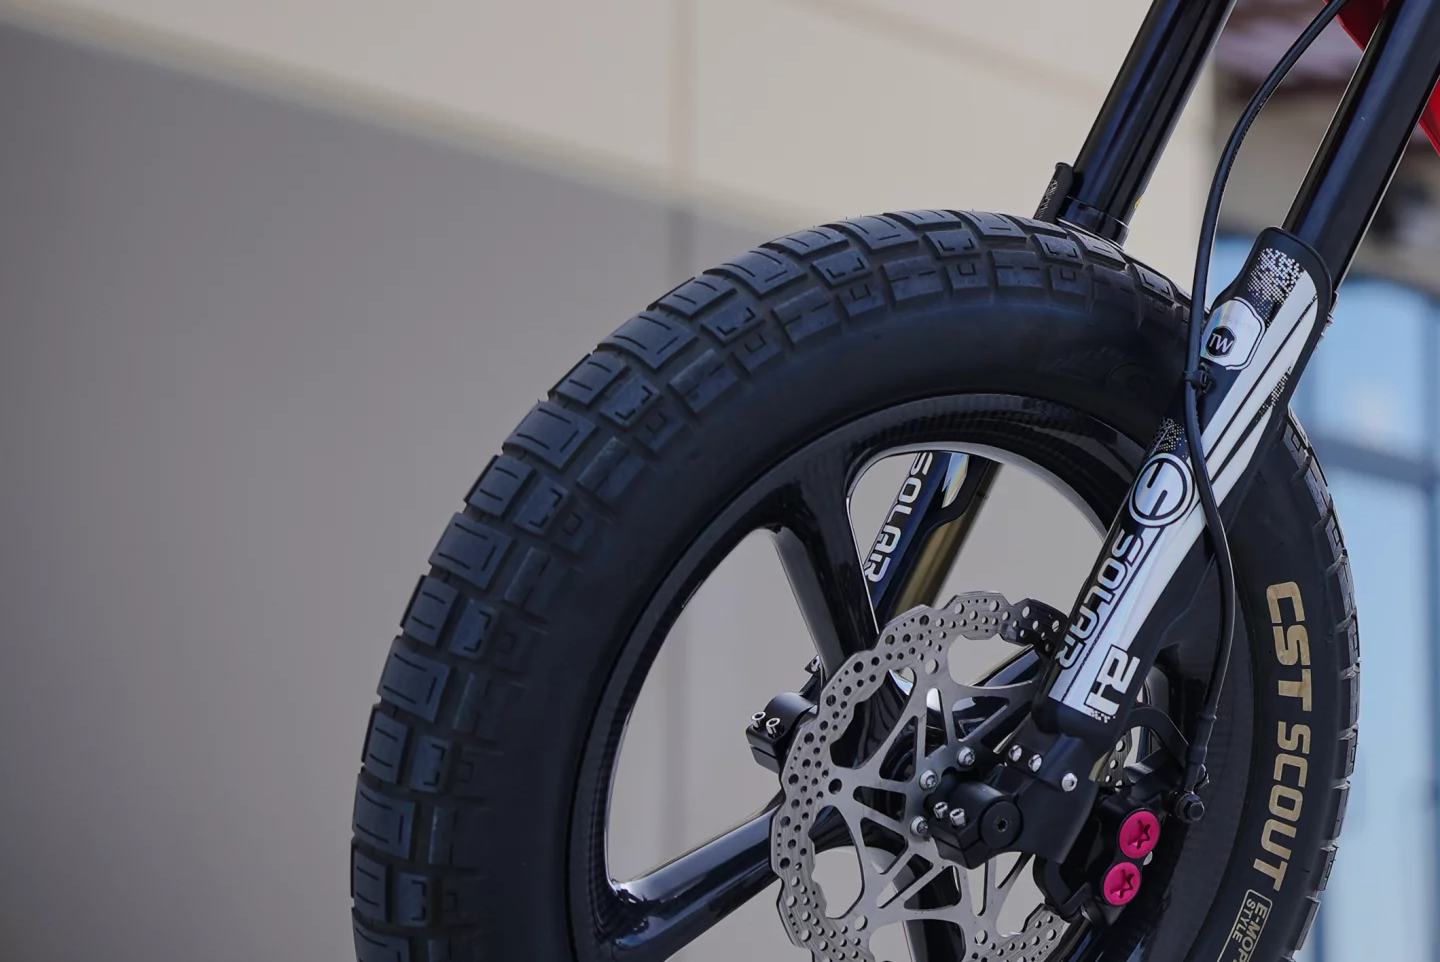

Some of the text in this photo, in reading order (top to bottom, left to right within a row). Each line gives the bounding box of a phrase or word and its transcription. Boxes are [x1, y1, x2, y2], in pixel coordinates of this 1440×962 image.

[1209, 333, 1233, 353] TW
[864, 452, 933, 583] SOLAR
[1055, 528, 1142, 670] SOLAR
[1253, 581, 1313, 892] CST SCOUT
[1232, 899, 1256, 943] STYLE
[1233, 902, 1268, 962] E-MOP
